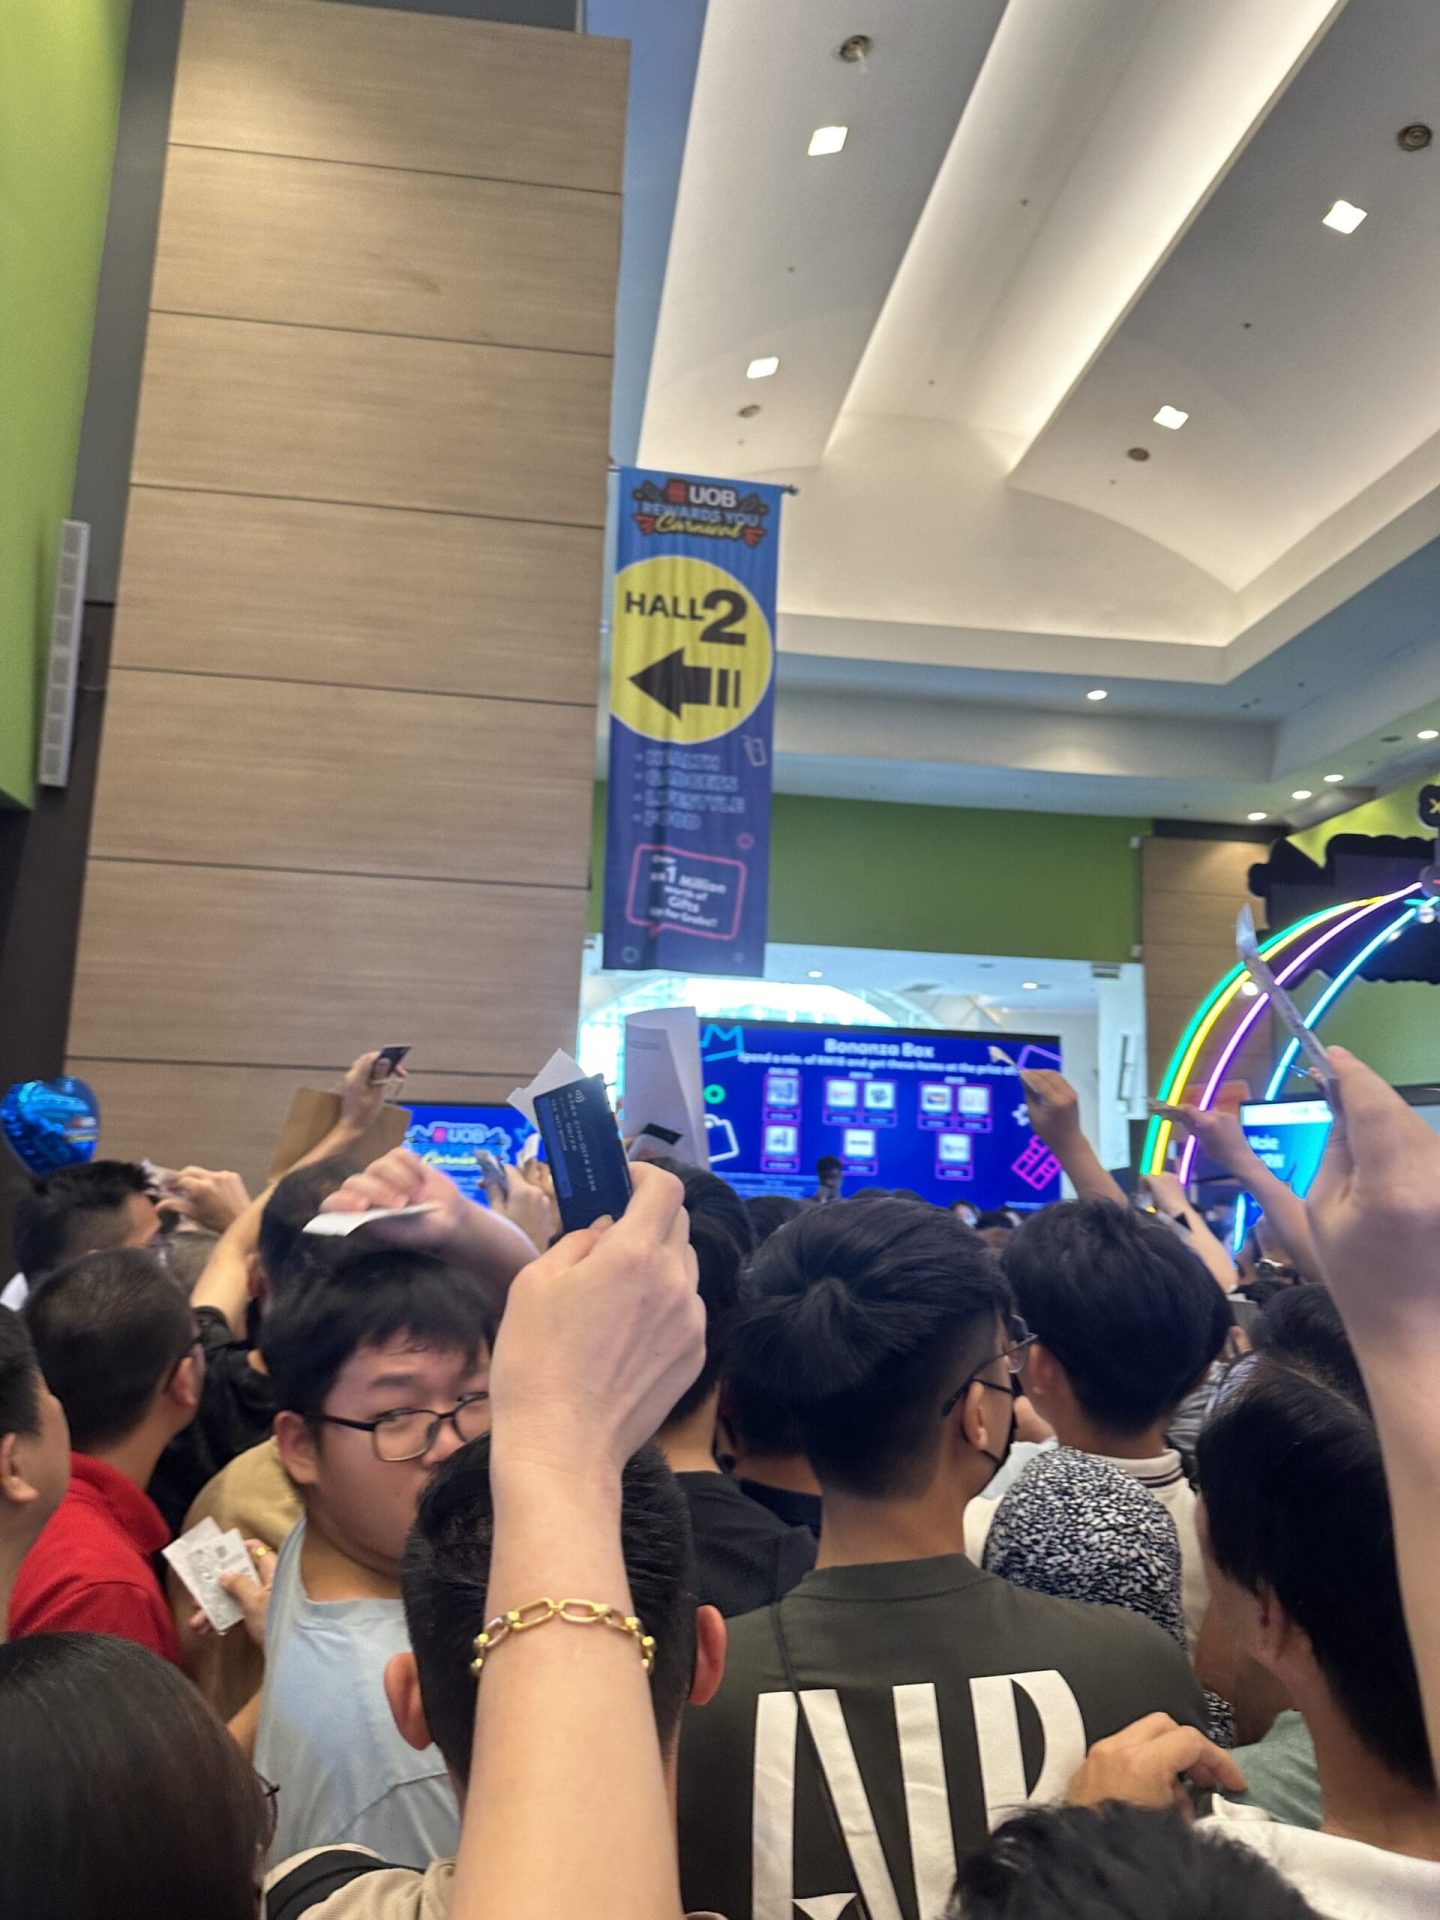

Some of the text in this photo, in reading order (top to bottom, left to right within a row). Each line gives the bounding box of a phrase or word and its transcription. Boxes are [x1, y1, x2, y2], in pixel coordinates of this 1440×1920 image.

[689, 485, 738, 508] UOB
[655, 514, 742, 537] Carnival
[625, 589, 749, 647] HALL 2
[825, 1038, 935, 1058] Bonanza Box
[447, 1127, 486, 1144] UOB
